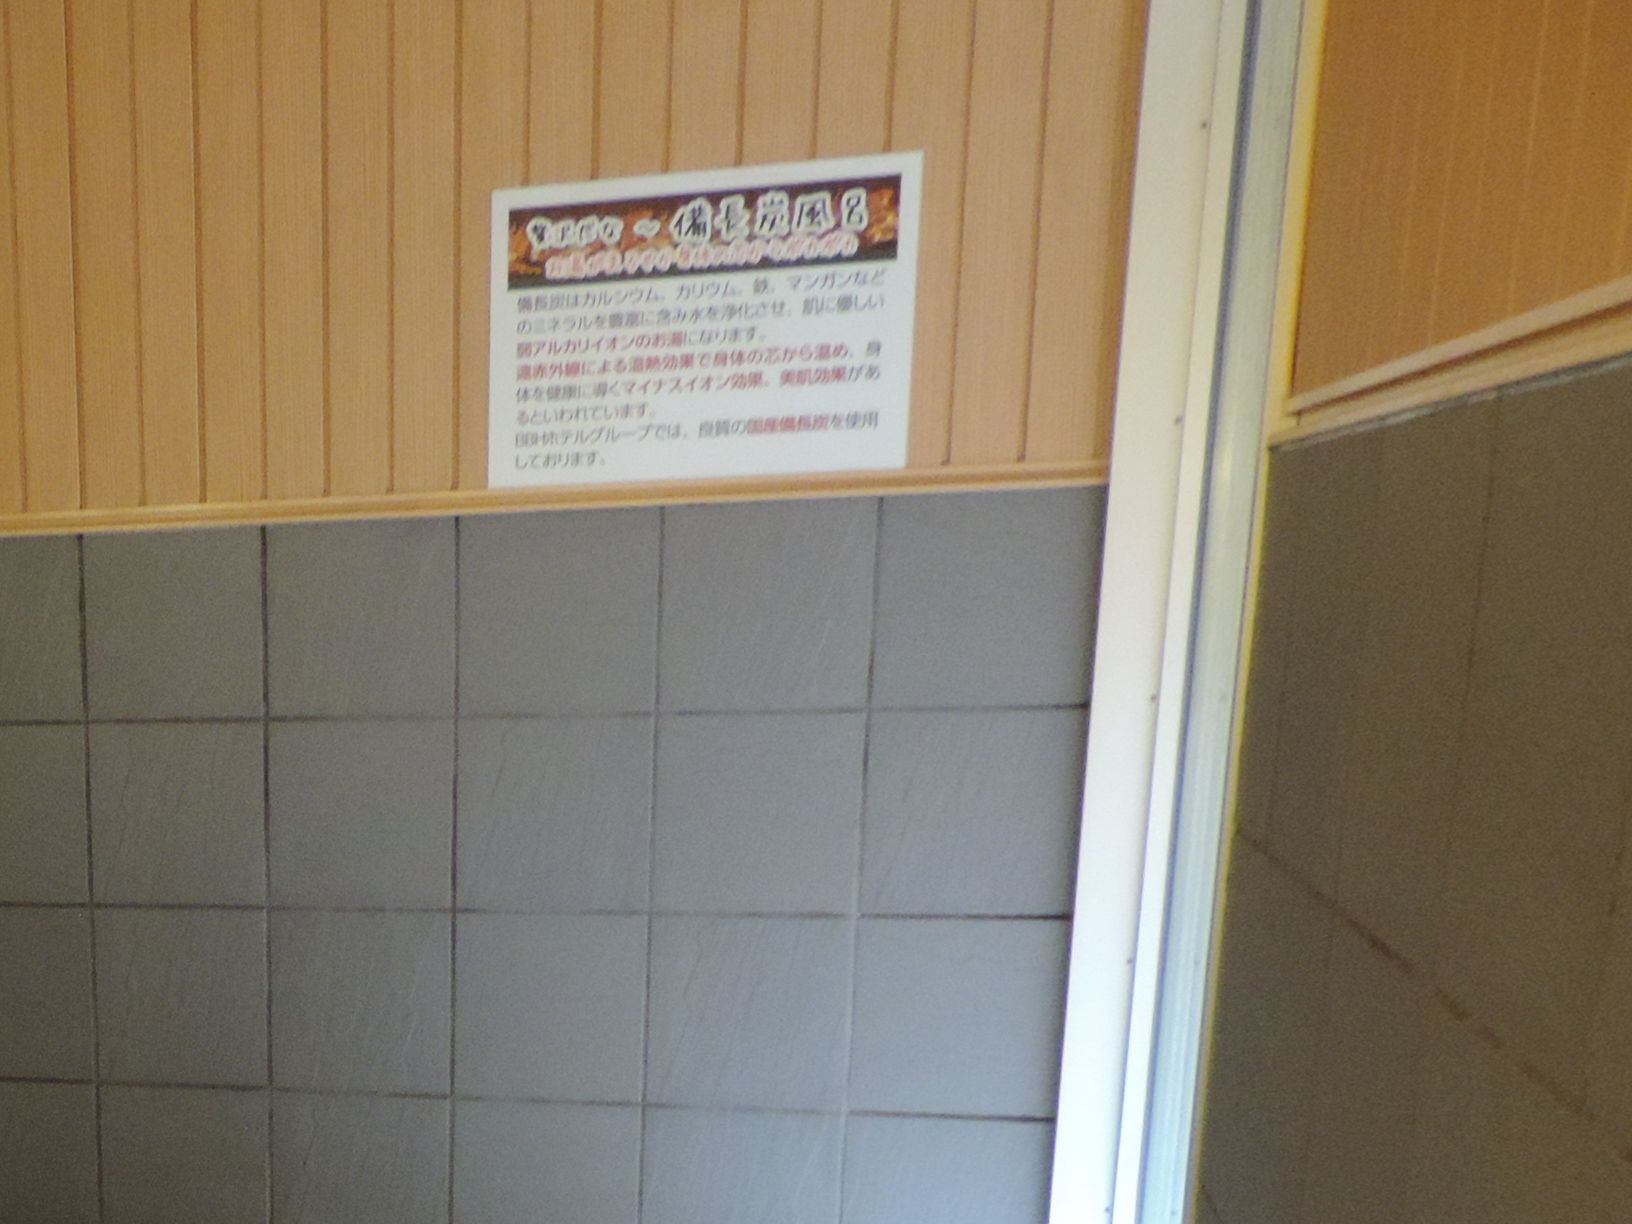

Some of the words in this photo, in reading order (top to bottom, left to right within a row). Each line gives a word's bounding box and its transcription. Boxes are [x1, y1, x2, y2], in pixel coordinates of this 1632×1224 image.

[516, 401, 656, 426] るといわれています。
[514, 449, 606, 471] しております。
